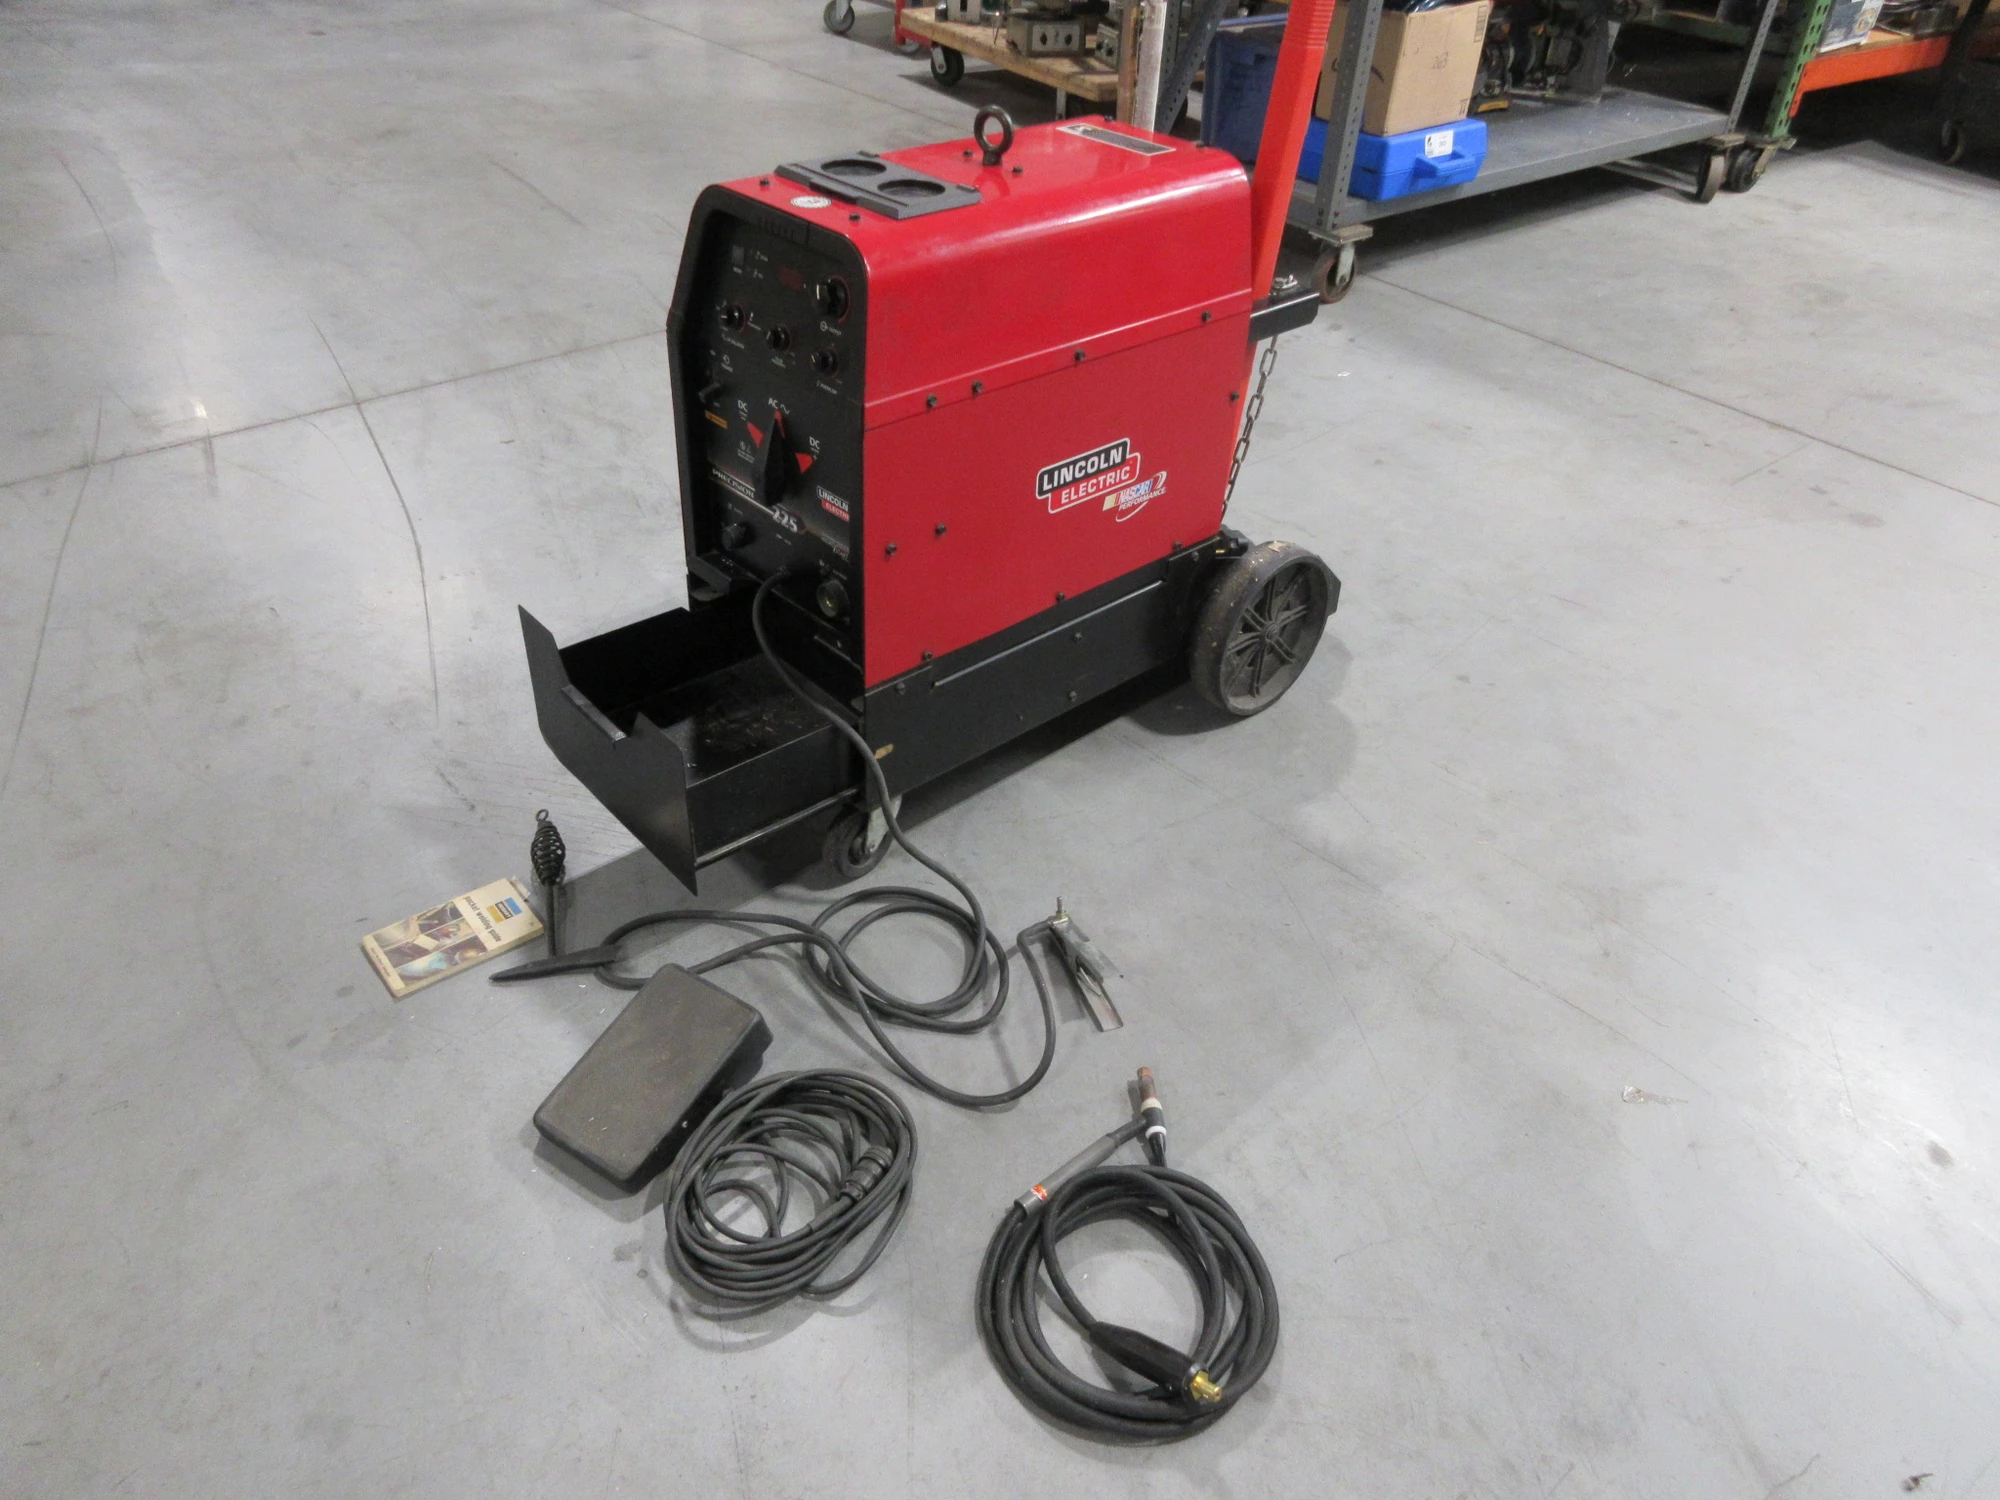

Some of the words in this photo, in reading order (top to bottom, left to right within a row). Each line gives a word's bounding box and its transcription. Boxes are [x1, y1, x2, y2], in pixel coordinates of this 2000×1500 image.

[737, 400, 748, 412] DC
[768, 397, 779, 409] AC
[809, 436, 820, 449] DC
[1043, 446, 1123, 491] LINCOLN
[712, 468, 755, 498] PRECISION
[1061, 466, 1130, 504] ELECTRIC
[1119, 478, 1153, 503] NASCAR
[818, 488, 849, 512] LINCOLN
[826, 502, 849, 520] ELECTRI
[1118, 486, 1167, 511] PERFORMANCE
[772, 505, 798, 533] 225
[464, 895, 480, 914] pocket
[475, 911, 492, 931] welding
[487, 927, 502, 942] guide
